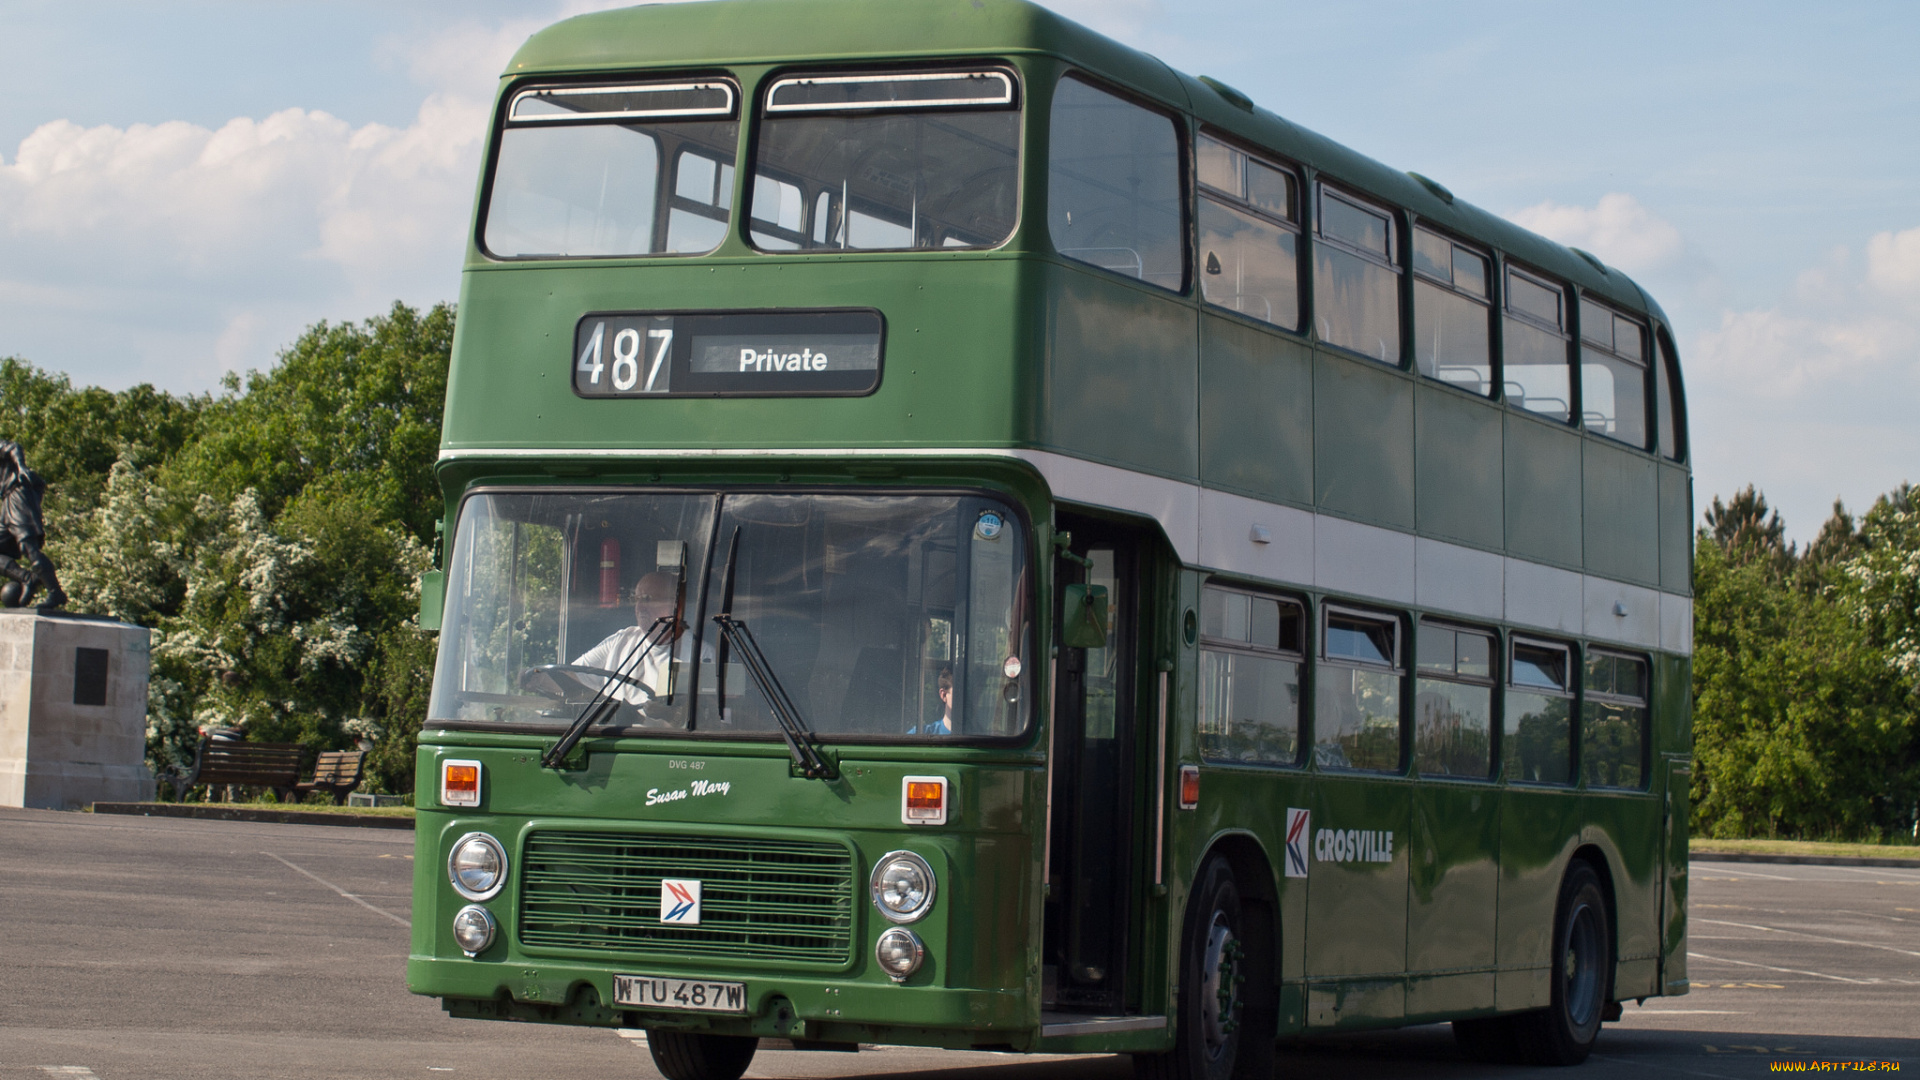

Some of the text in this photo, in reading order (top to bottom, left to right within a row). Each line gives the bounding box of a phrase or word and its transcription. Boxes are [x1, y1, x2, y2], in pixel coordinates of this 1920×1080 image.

[577, 321, 674, 391] 487
[739, 348, 828, 372] Private
[669, 760, 705, 770] DVG 487
[645, 780, 731, 806] Susan Mary
[1315, 828, 1393, 863] CROSVILLE
[617, 978, 743, 1009] WTU 487W
